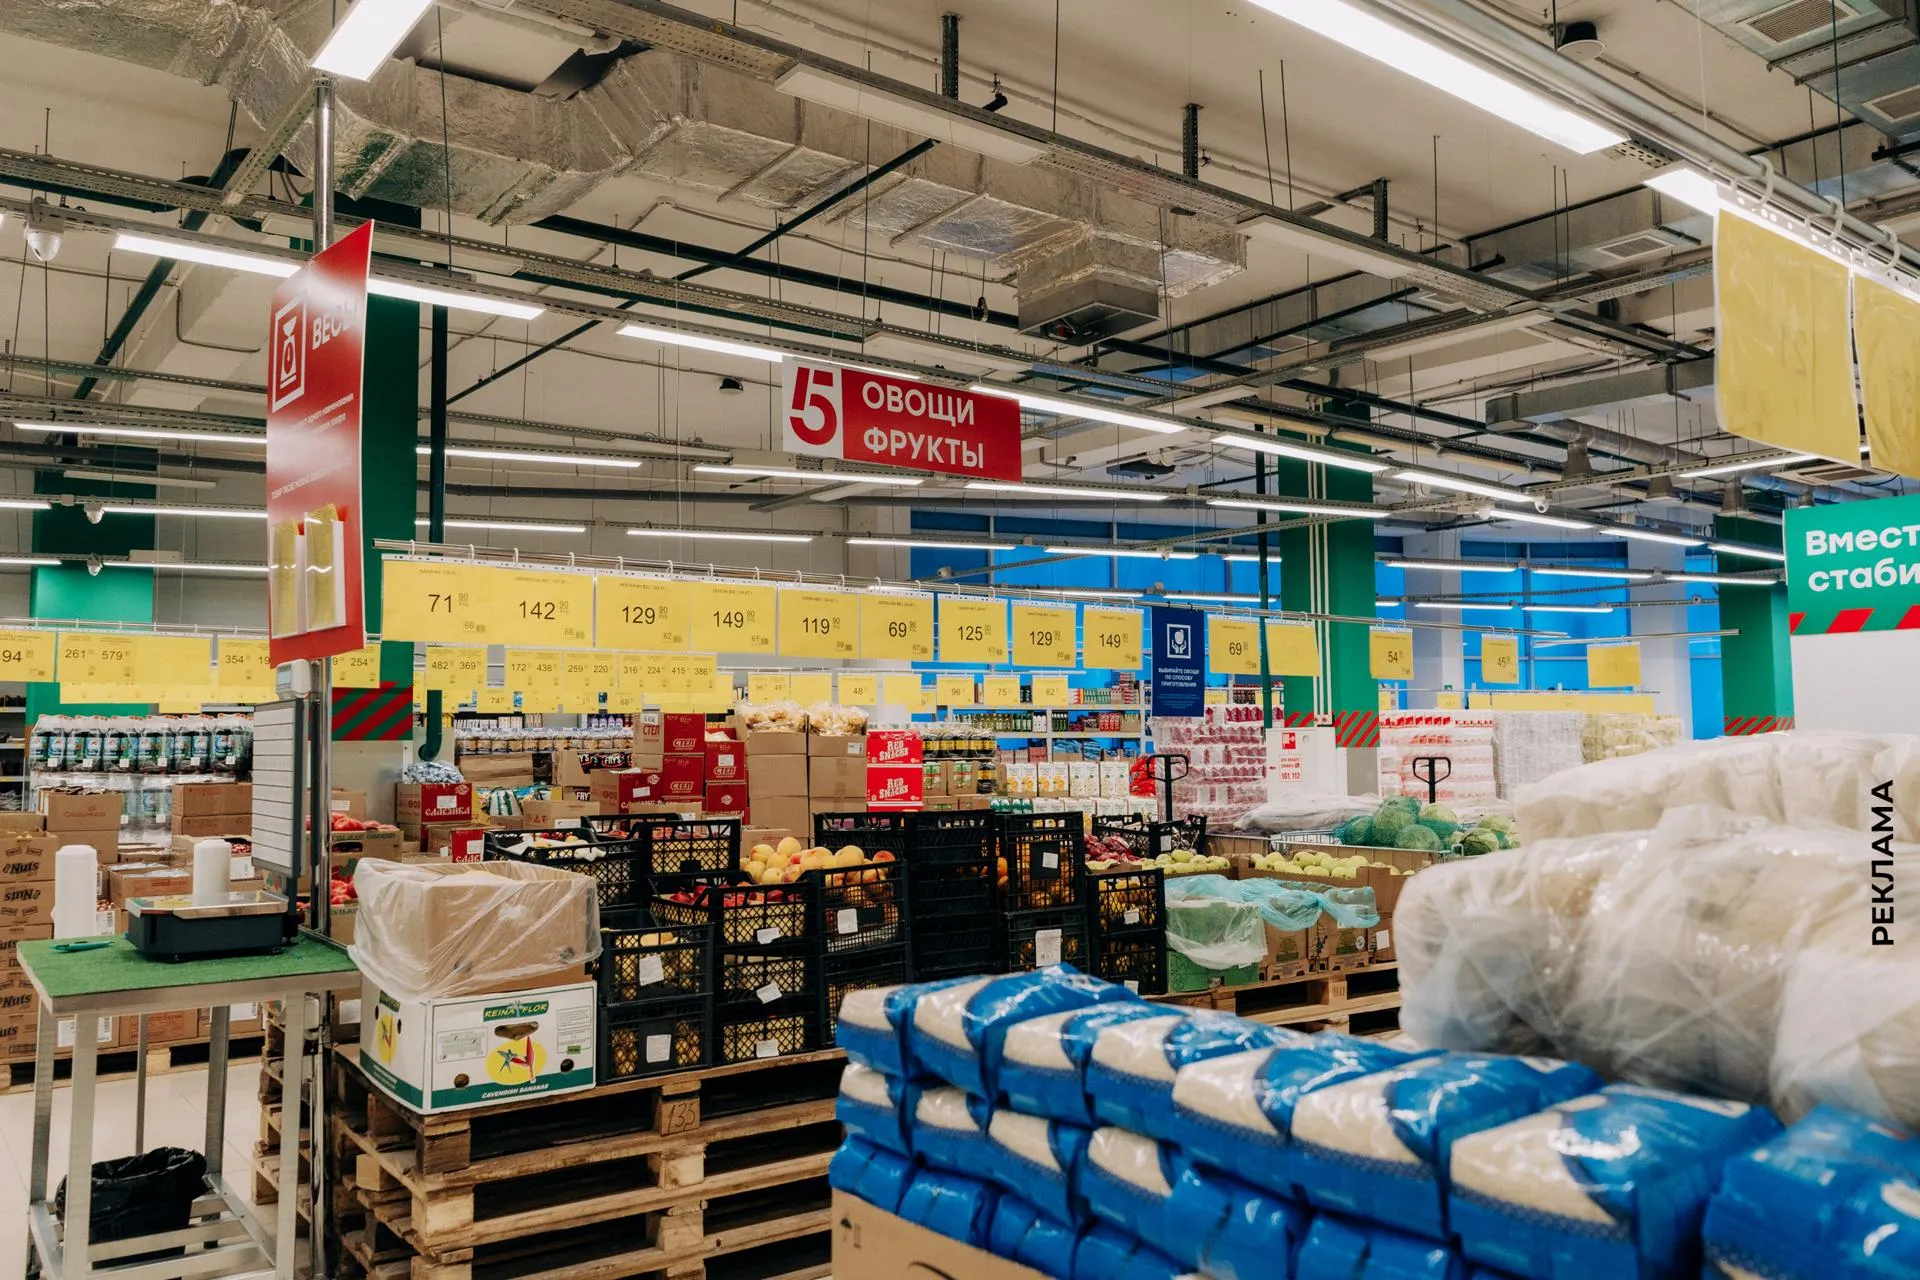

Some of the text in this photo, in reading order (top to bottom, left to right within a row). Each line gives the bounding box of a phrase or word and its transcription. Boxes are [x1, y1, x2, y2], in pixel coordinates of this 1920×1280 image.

[862, 381, 975, 427] ОВОЩИ
[863, 426, 984, 469] ФРУКТЫ
[1805, 524, 1920, 556] Вмест
[1808, 557, 1920, 592] стаби
[428, 594, 452, 613] 71
[519, 600, 556, 620] 142
[622, 605, 655, 625] 129
[713, 610, 744, 628] 149
[802, 617, 830, 635] 119
[888, 621, 907, 638] 69
[958, 625, 983, 641] 125
[1029, 631, 1053, 646] 129
[1099, 633, 1121, 649] 149
[2, 649, 22, 663] 94
[65, 649, 86, 659] 261
[101, 650, 123, 661] 579
[1229, 642, 1242, 656] 69
[225, 654, 244, 664] 354
[350, 657, 368, 667] 254
[1388, 651, 1399, 663] 54
[431, 661, 449, 670] 482
[459, 661, 476, 670] 369
[511, 663, 527, 672] 172
[567, 664, 584, 673] 259
[593, 664, 609, 673] 220
[623, 666, 638, 674] 316
[671, 667, 686, 675] 415
[887, 740, 904, 751] RED
[879, 747, 909, 761] SNACKS
[887, 778, 904, 788] RED
[879, 785, 909, 799] SNACKS
[10, 861, 40, 874] Nuts
[2, 994, 33, 1008] Nuts
[484, 1003, 548, 1019] REINA FLOR
[481, 1083, 549, 1099] CAVENDISH BANANAS
